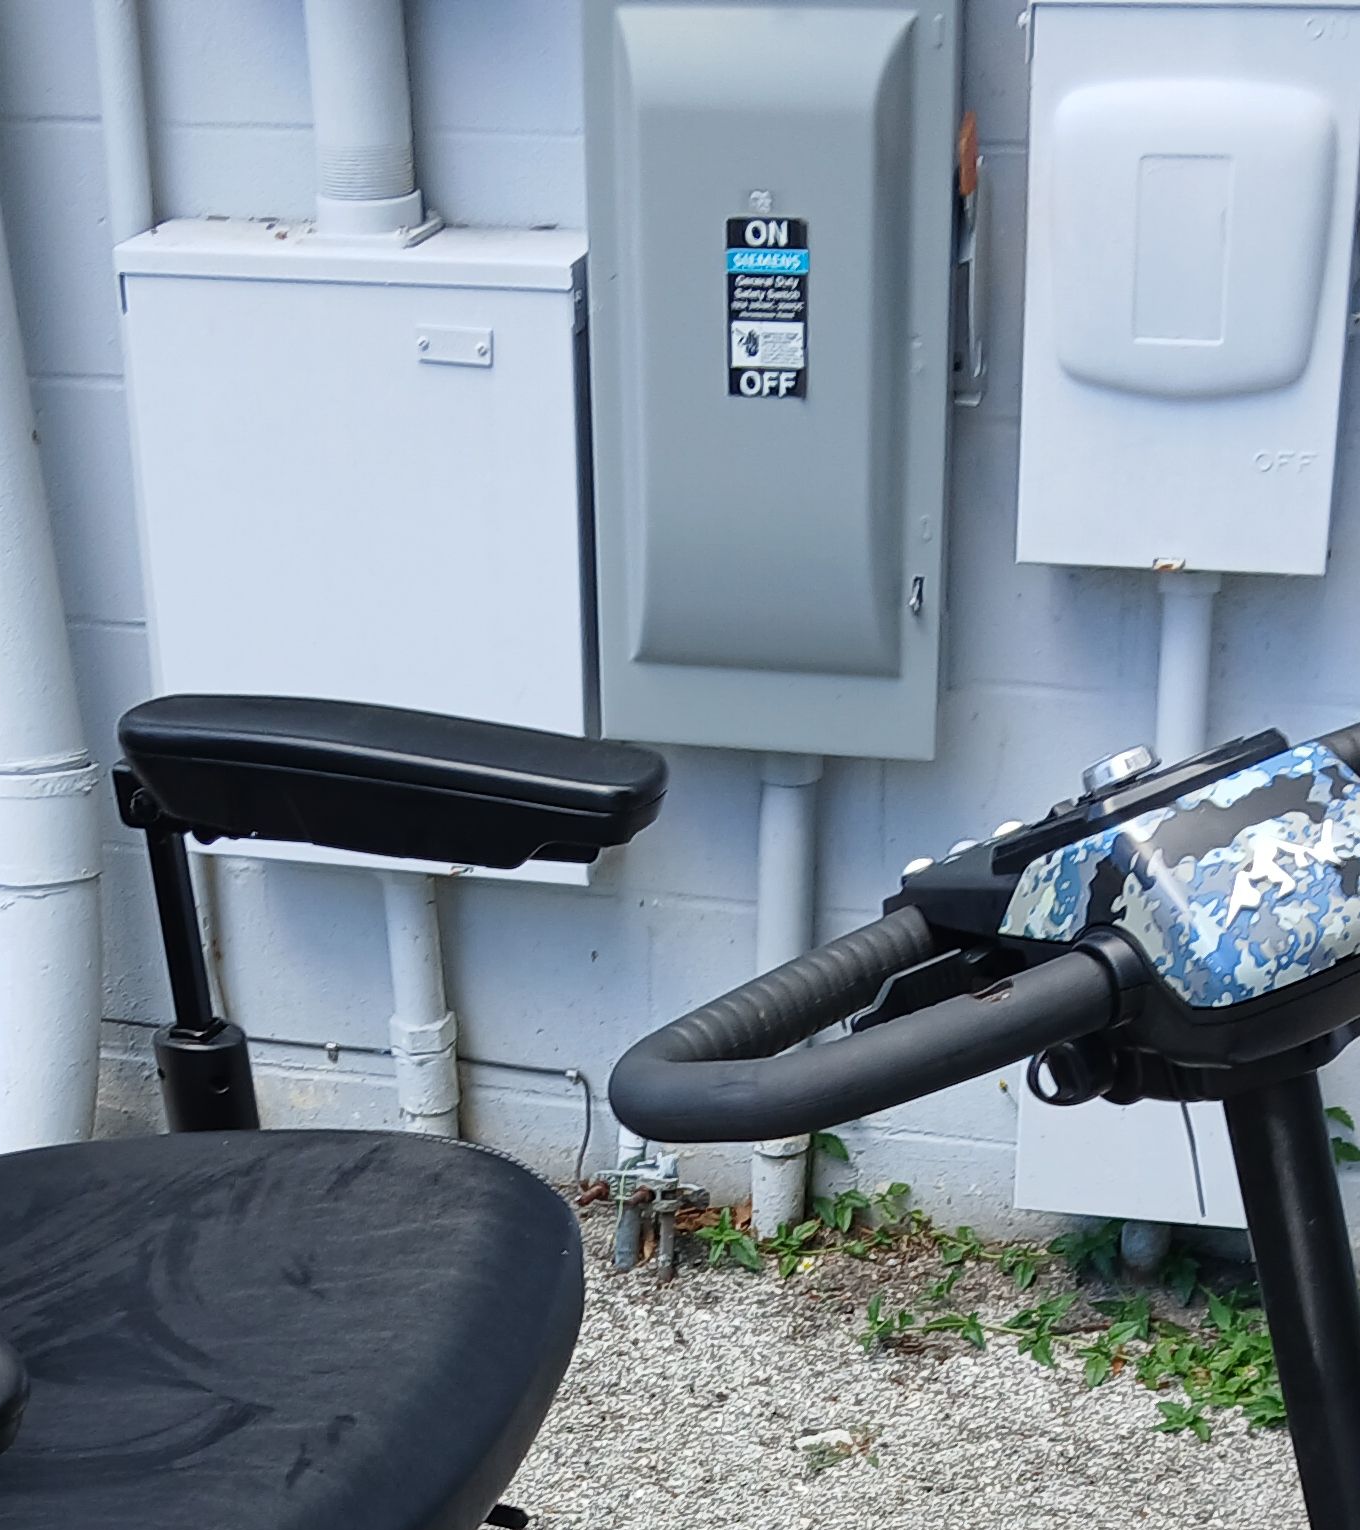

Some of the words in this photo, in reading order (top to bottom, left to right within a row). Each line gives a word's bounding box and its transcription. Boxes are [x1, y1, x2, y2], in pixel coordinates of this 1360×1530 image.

[743, 219, 790, 248] ON
[732, 252, 802, 272] SIEMENS
[738, 369, 798, 399] OFF
[1251, 449, 1322, 475] OFF
